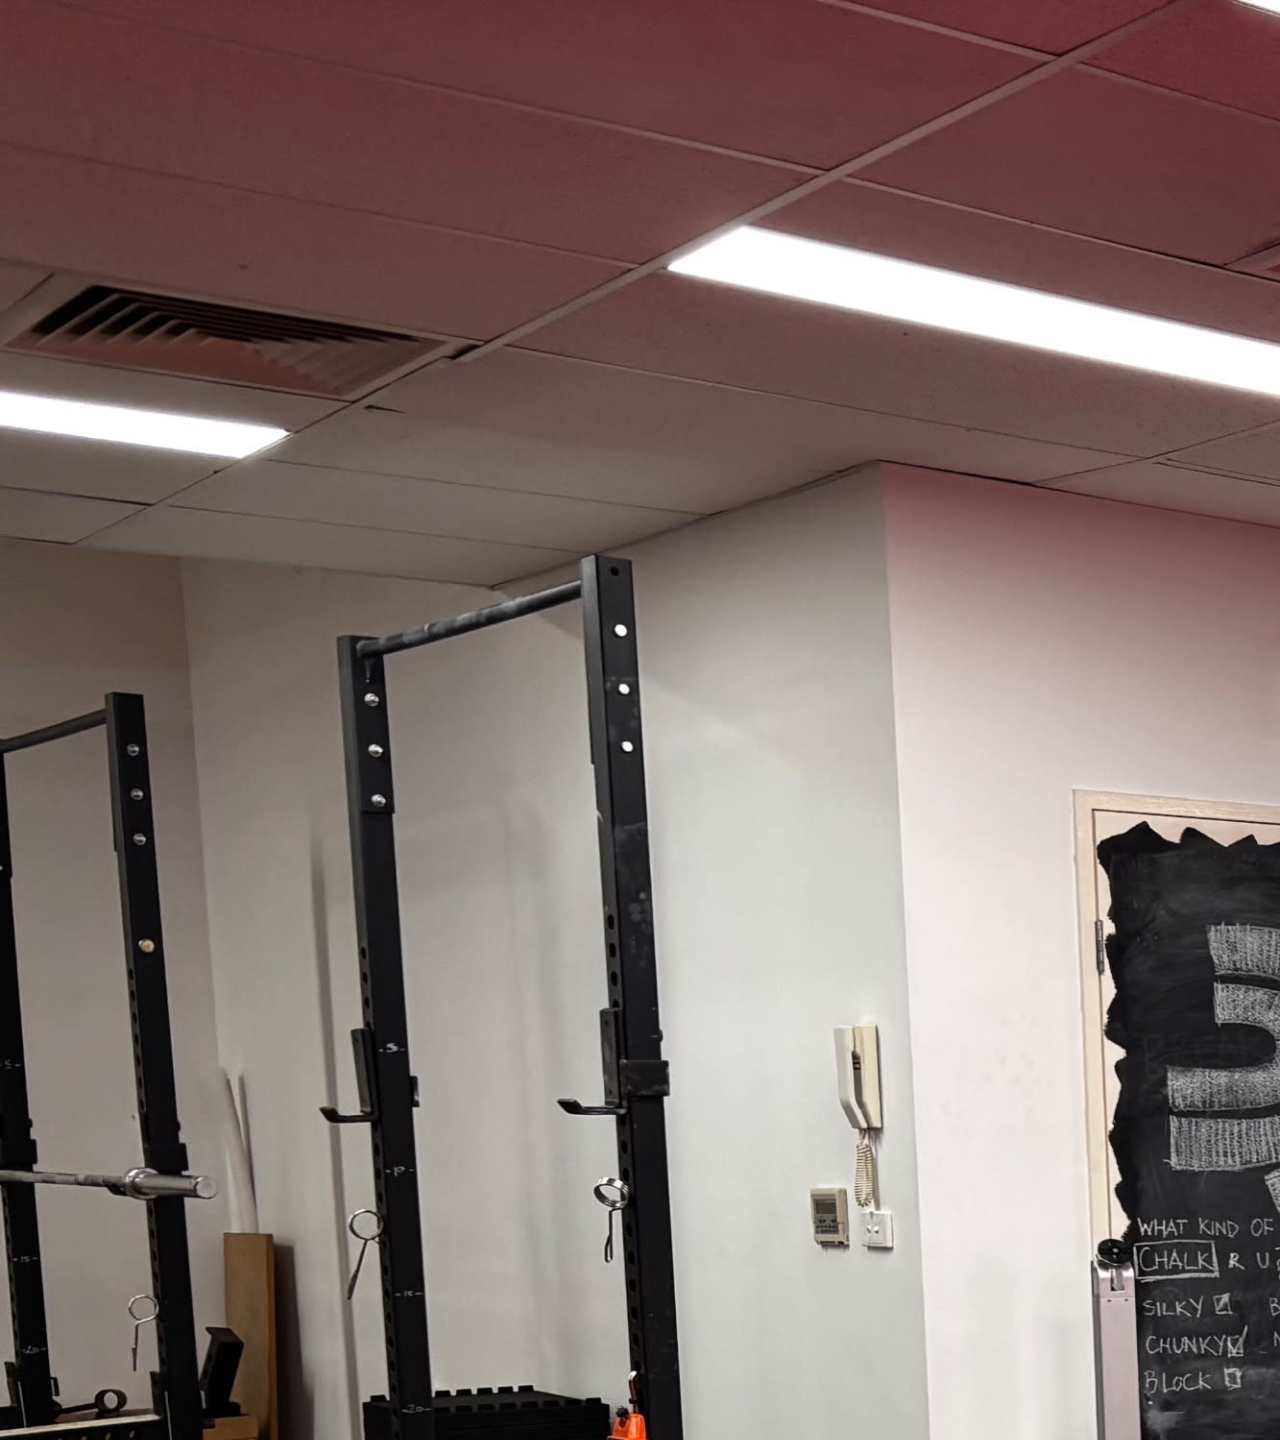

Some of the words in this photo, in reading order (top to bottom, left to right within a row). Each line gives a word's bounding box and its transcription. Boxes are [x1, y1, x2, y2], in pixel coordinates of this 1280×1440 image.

[1137, 1217, 1188, 1238] WHAT
[1199, 1217, 1239, 1238] KIND
[1250, 1218, 1274, 1238] OF
[1139, 1247, 1216, 1272] CHALK
[1228, 1252, 1245, 1270] R
[1142, 1297, 1204, 1318] SILKY
[1145, 1335, 1227, 1356] CHUNKY
[1144, 1370, 1212, 1393] BLOCK
